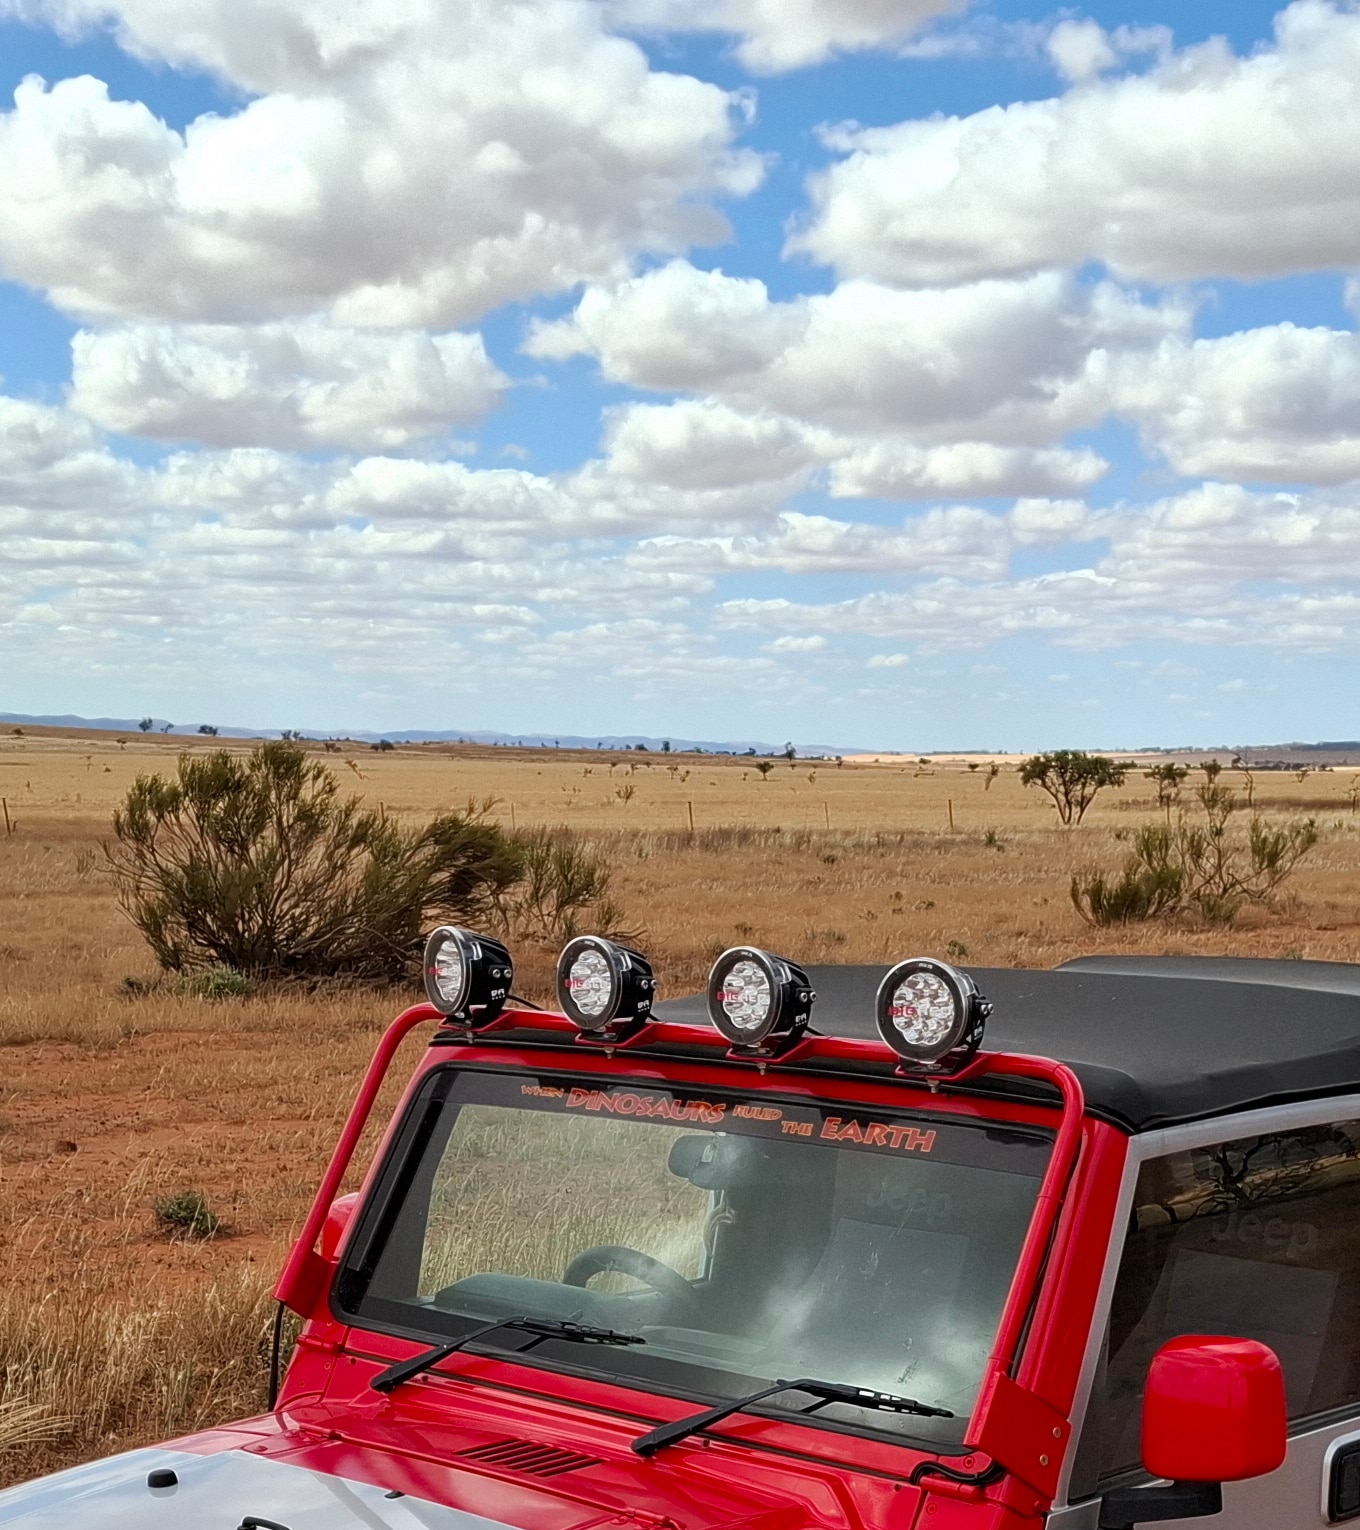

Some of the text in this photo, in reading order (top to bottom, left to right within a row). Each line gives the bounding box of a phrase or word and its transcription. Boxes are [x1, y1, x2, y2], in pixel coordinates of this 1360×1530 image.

[566, 1087, 727, 1124] DINOSAURS
[732, 1104, 783, 1120] RULED
[781, 1120, 814, 1136] THE
[820, 1117, 937, 1153] EARTH
[1211, 1206, 1319, 1258] Jeep
